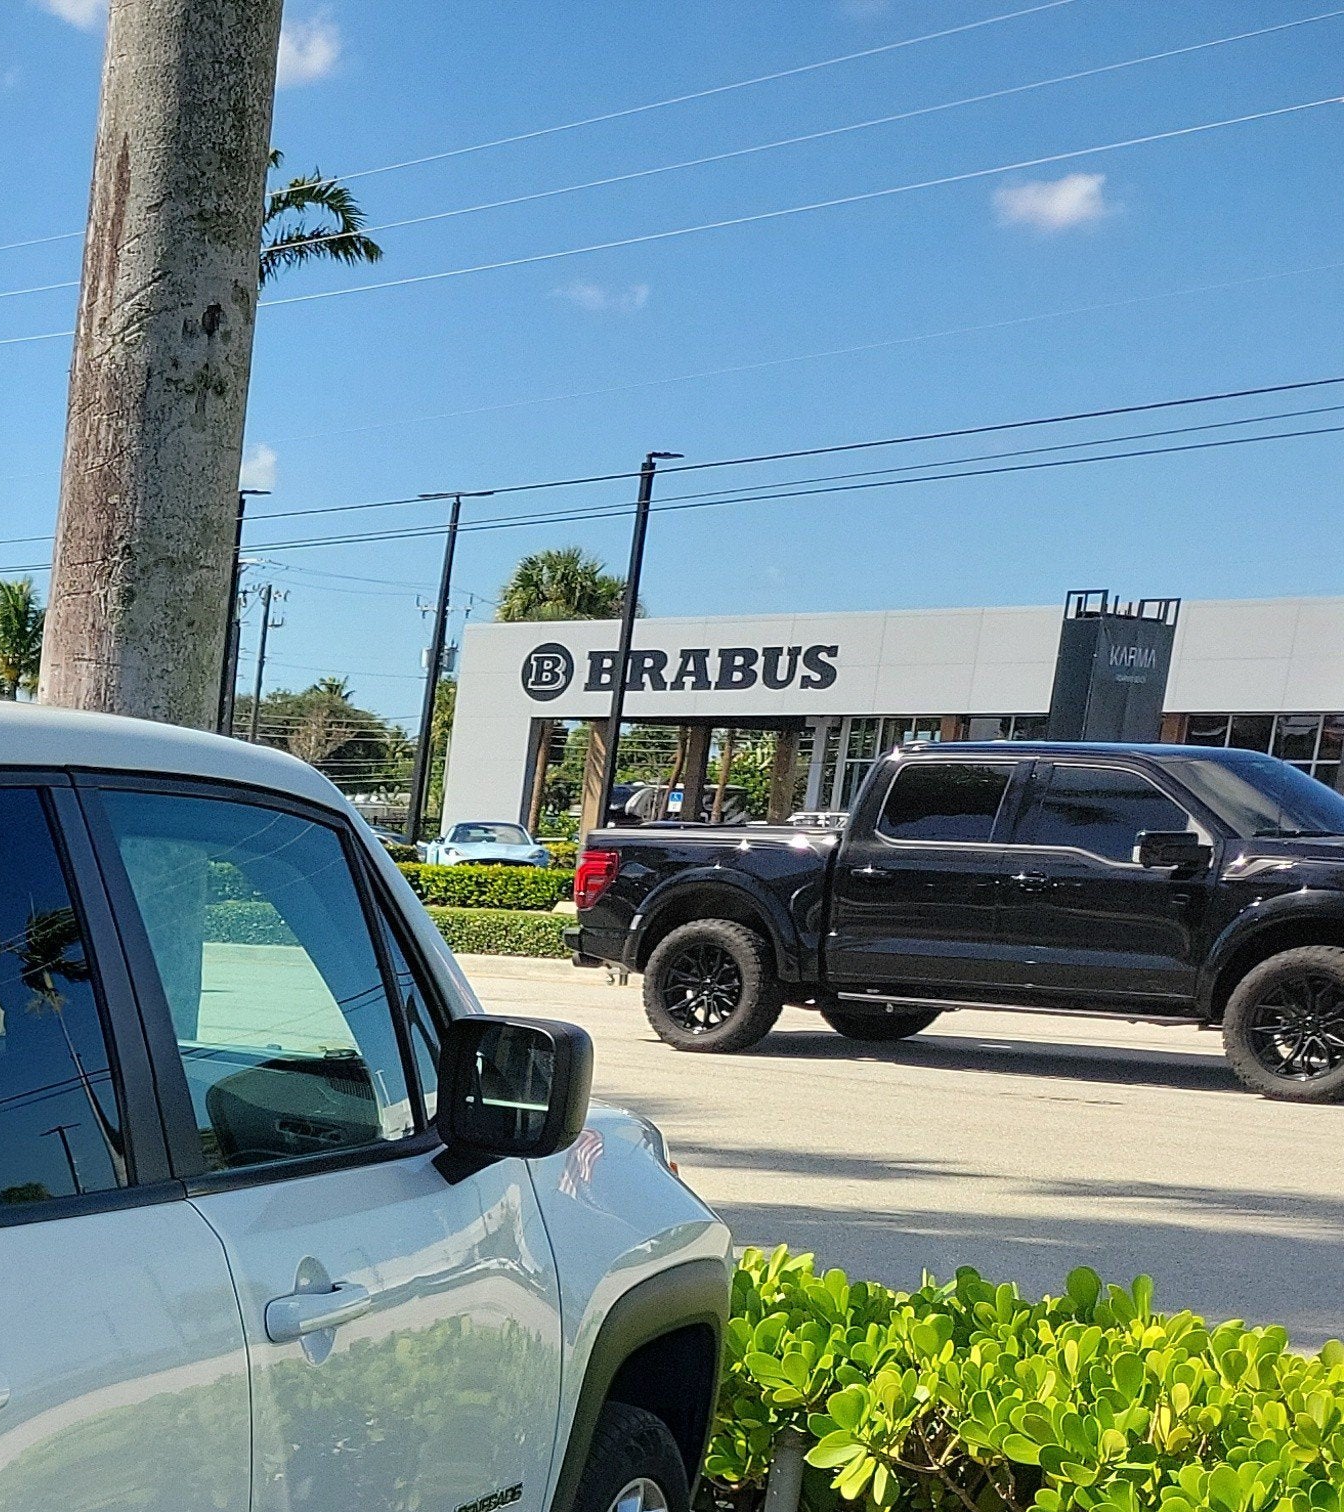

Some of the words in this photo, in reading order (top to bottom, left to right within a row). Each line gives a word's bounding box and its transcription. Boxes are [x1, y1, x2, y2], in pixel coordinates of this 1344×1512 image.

[528, 653, 567, 690] B
[583, 645, 839, 692] BRABUS
[1110, 645, 1156, 669] KARMA
